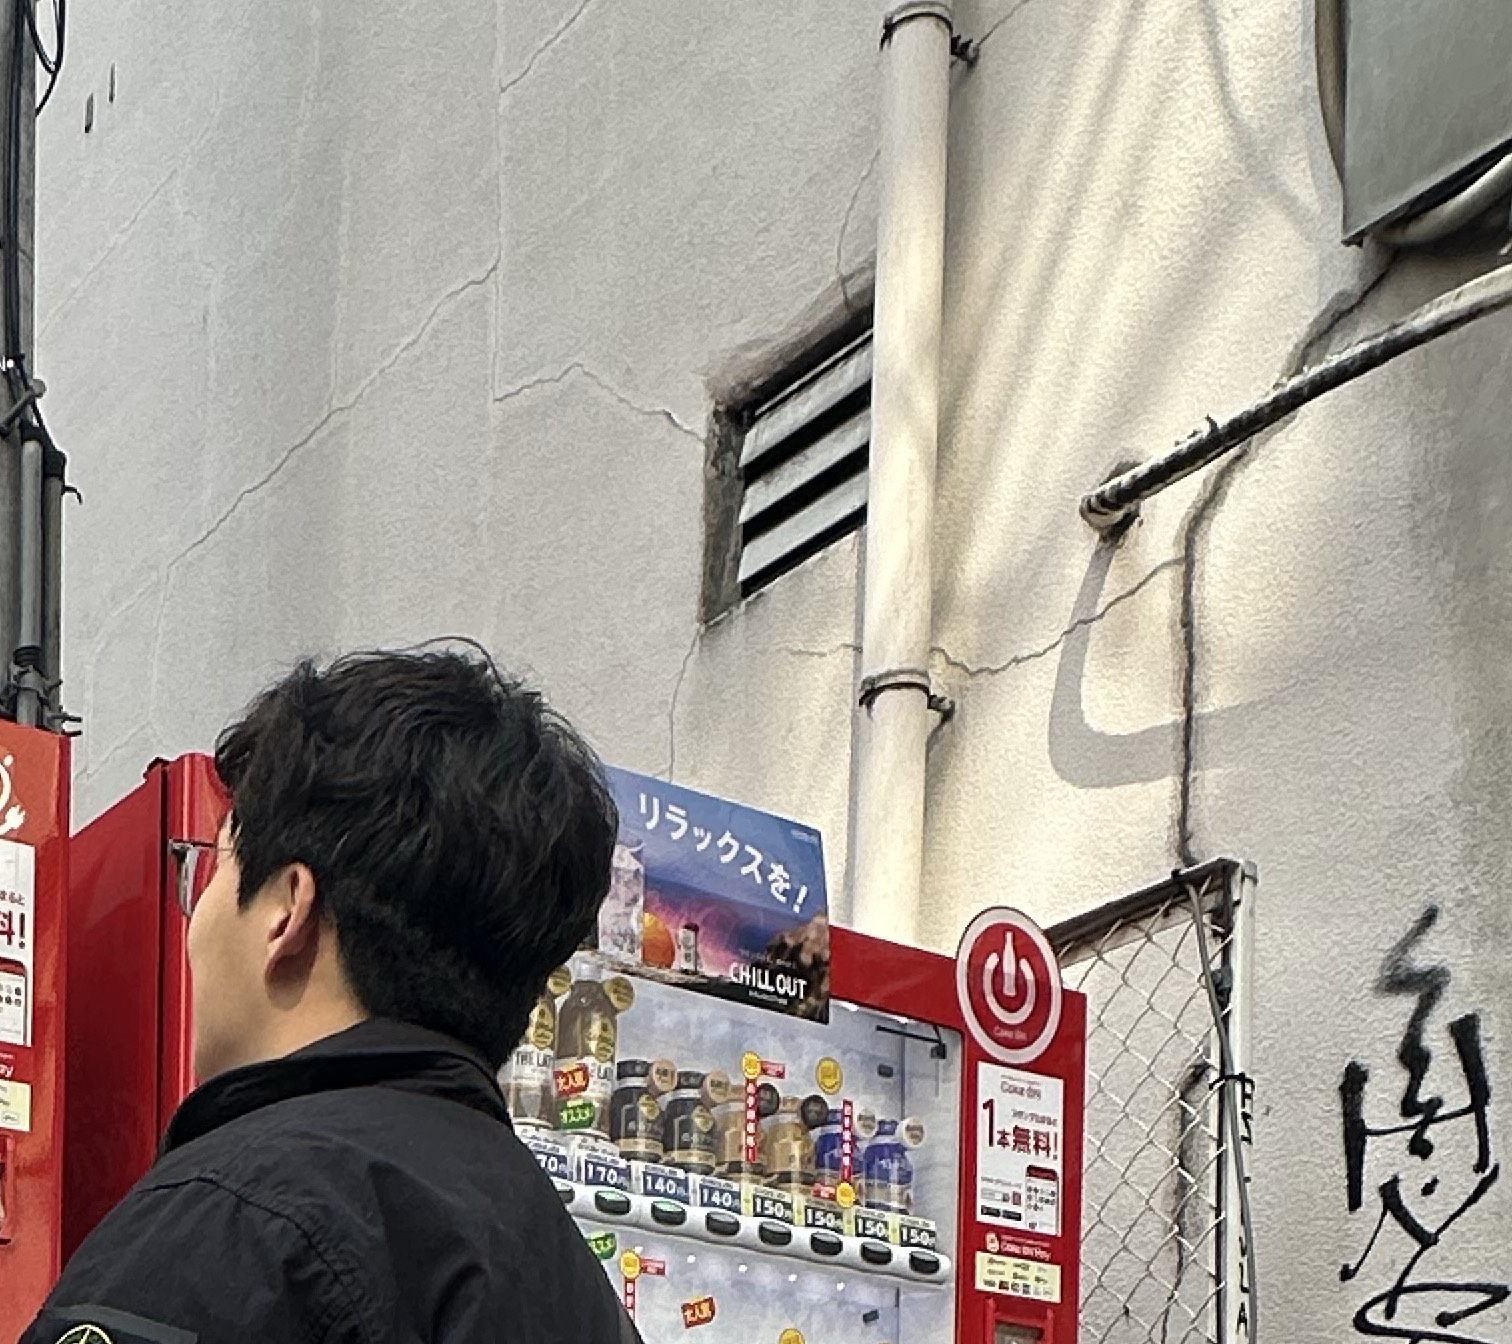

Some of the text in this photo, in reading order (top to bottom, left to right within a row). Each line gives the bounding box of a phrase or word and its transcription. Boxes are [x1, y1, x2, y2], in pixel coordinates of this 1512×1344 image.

[638, 793, 810, 914] リラックスを!
